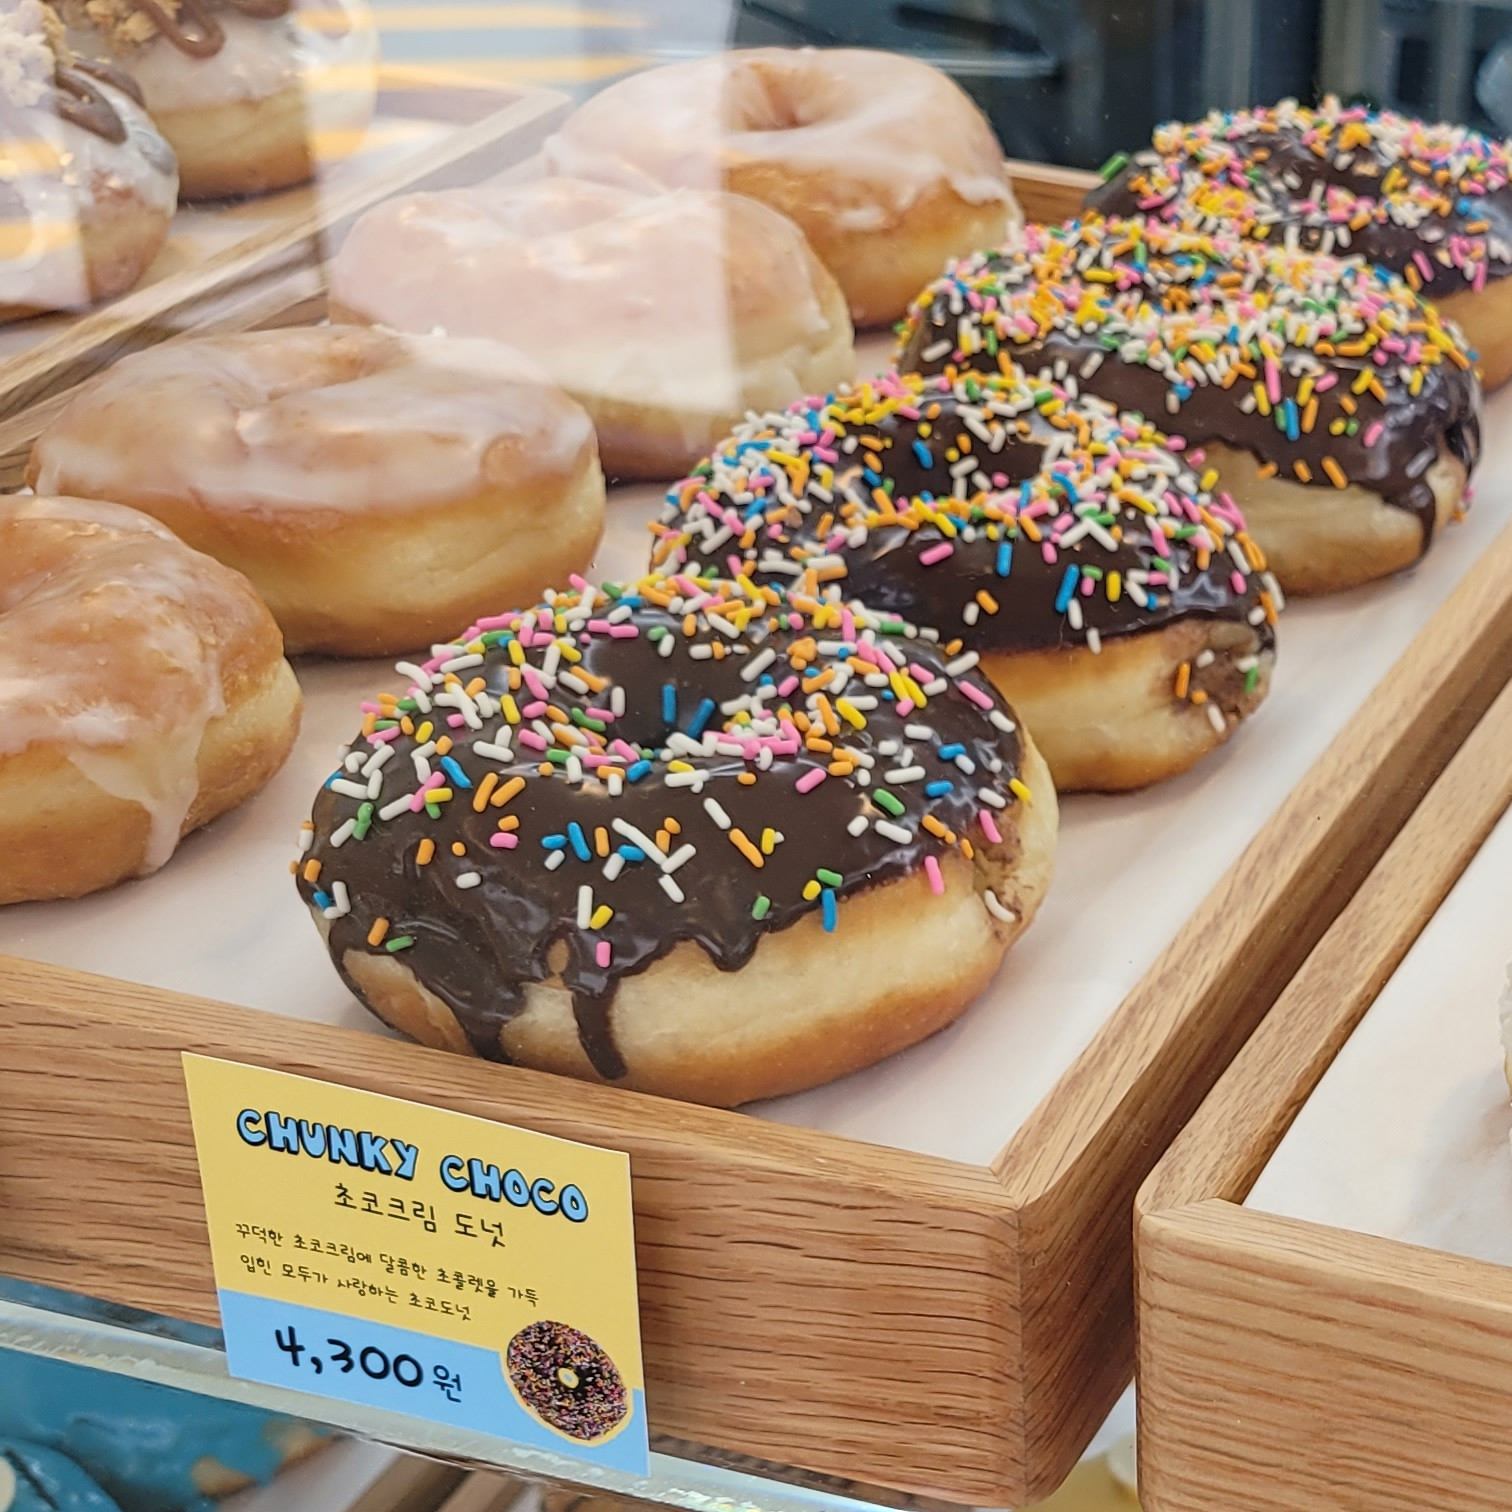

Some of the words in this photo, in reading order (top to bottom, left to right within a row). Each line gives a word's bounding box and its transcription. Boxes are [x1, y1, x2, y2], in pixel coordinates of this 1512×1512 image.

[236, 1108, 419, 1179] CHUNKY
[440, 1154, 589, 1222] CHOCO
[334, 1182, 437, 1232] 초코크림
[455, 1213, 506, 1248] 도넛
[236, 1223, 283, 1246] 꾸덕한
[294, 1234, 372, 1265] 초코크림에
[379, 1253, 427, 1280] 달콤한
[437, 1268, 499, 1298] 초콜렛을
[508, 1286, 540, 1306] 가득
[240, 1254, 271, 1276] 입힌
[282, 1262, 329, 1286] 모두가
[337, 1277, 398, 1303] 사랑하는
[409, 1292, 472, 1321] 초코도넛
